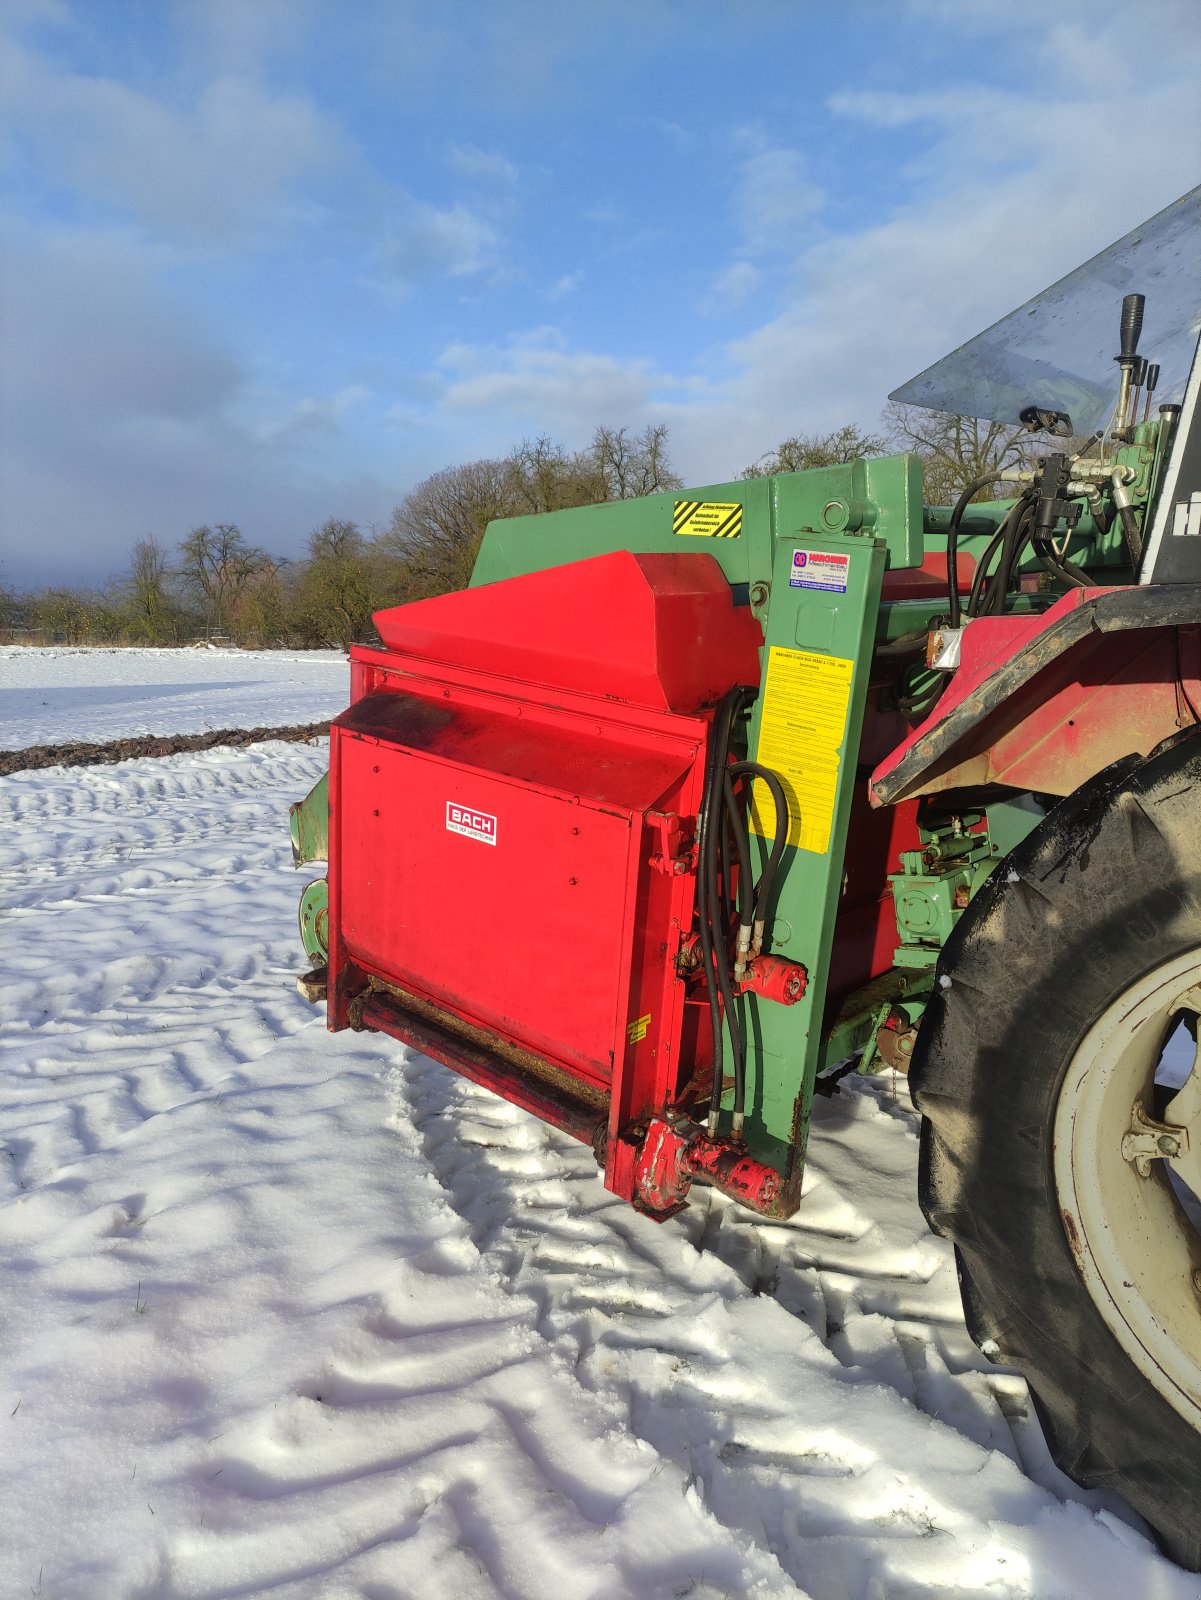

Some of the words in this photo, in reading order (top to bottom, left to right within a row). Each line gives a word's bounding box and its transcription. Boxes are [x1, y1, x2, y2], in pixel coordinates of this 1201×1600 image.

[808, 561, 847, 569] Maschinenbau
[452, 808, 491, 833] BACH
[447, 822, 459, 830] HAUS
[467, 829, 494, 842] LANDTECHNIK
